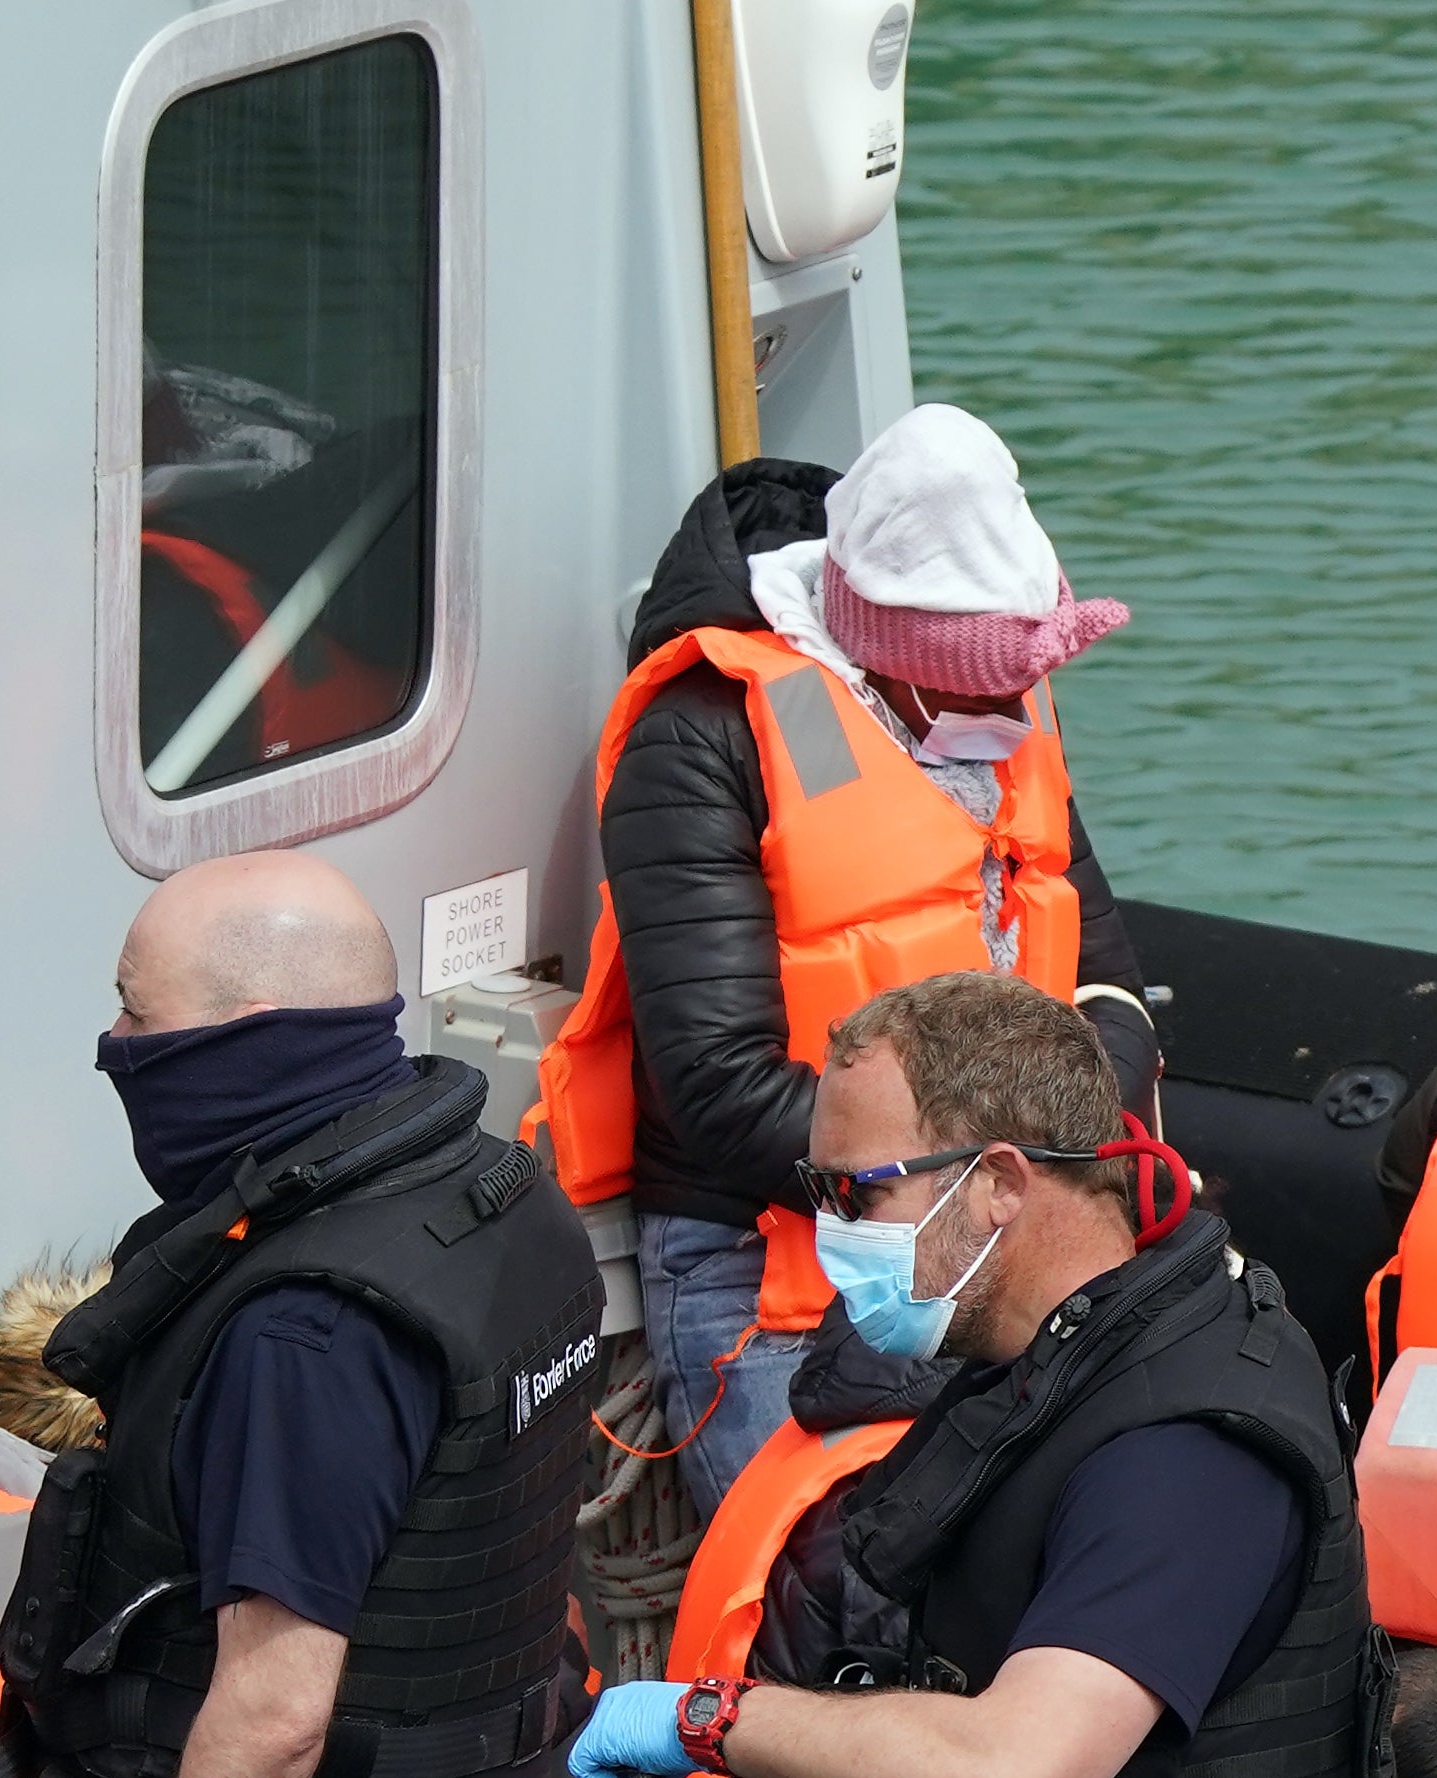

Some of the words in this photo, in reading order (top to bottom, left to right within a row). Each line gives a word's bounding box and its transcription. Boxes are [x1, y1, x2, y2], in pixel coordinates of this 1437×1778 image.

[448, 888, 504, 921] SHORE
[445, 915, 504, 949] POWER
[441, 941, 507, 977] SOCKET
